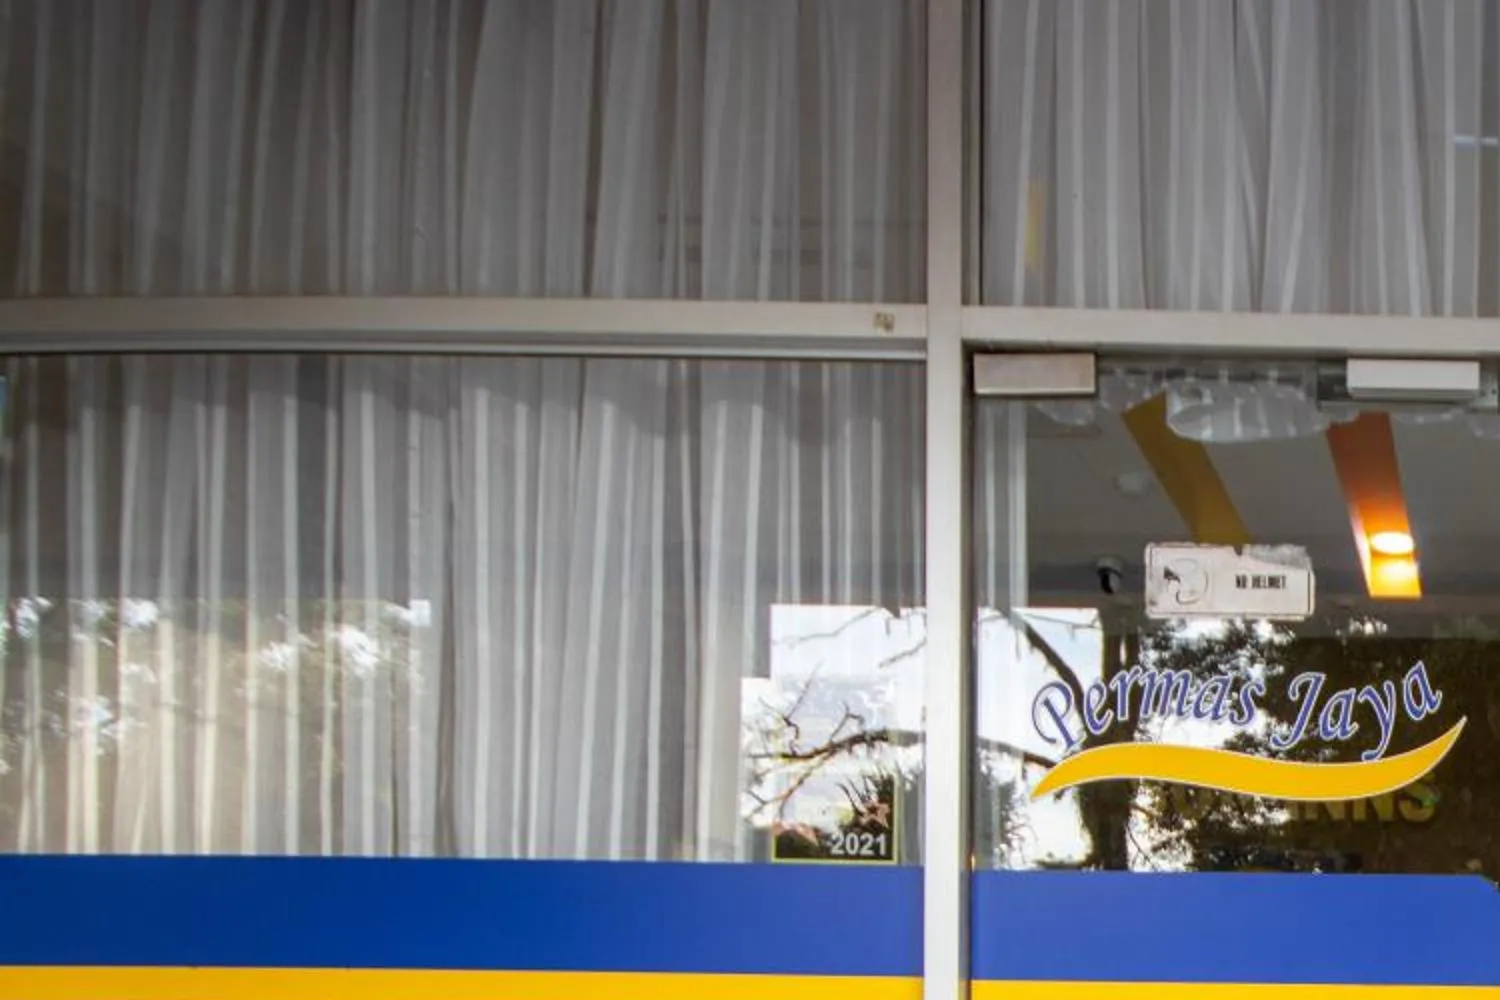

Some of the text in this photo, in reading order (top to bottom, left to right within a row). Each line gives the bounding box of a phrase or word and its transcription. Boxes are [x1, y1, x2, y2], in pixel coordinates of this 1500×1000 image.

[1236, 575, 1287, 589] NO HELMET
[1031, 659, 1443, 762] Permas Jaya
[830, 832, 887, 856] 2021
